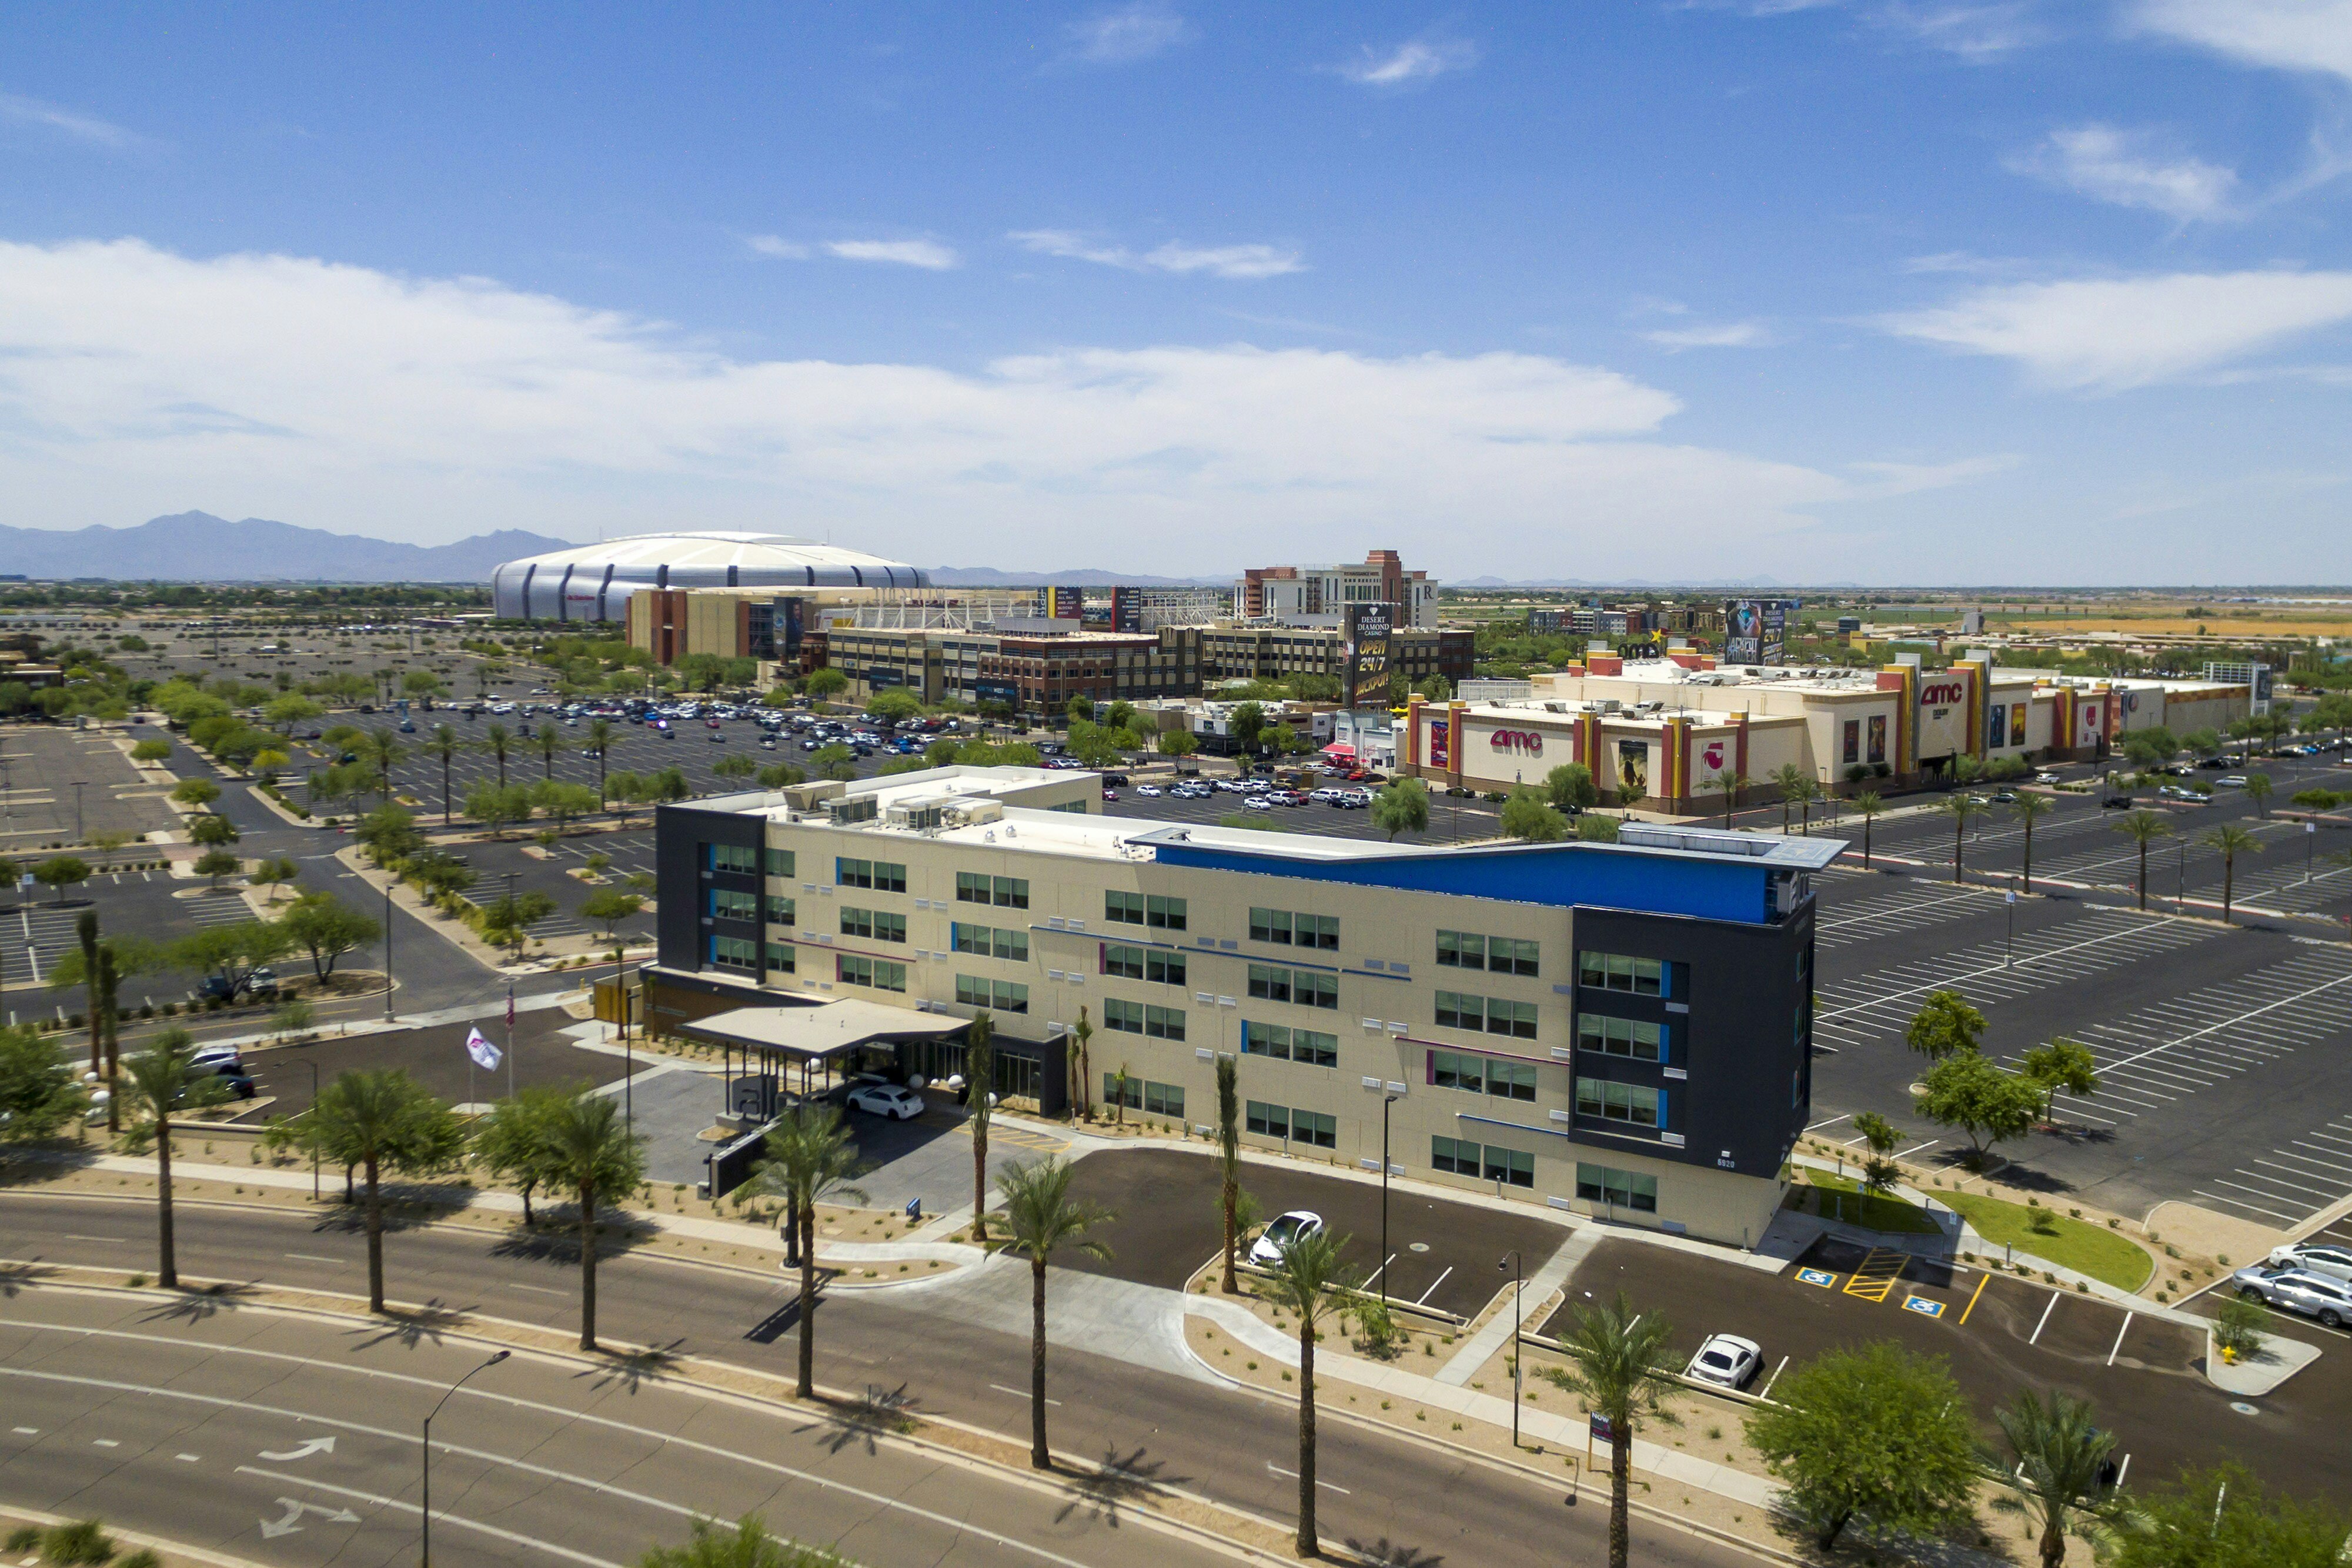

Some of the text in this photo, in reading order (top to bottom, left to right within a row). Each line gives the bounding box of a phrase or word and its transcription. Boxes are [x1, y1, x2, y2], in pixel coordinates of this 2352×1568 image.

[1424, 586, 1434, 599] R
[1359, 640, 1387, 655] OPEN
[1727, 637, 1759, 650] JACKPOT
[1726, 647, 1758, 663] POWER
[1359, 656, 1385, 672] 24/7
[1356, 672, 1389, 696] JACKPOT!
[1491, 730, 1542, 751] amc
[1717, 1158, 1735, 1168] 6920
[1591, 1412, 1609, 1423] NOW
